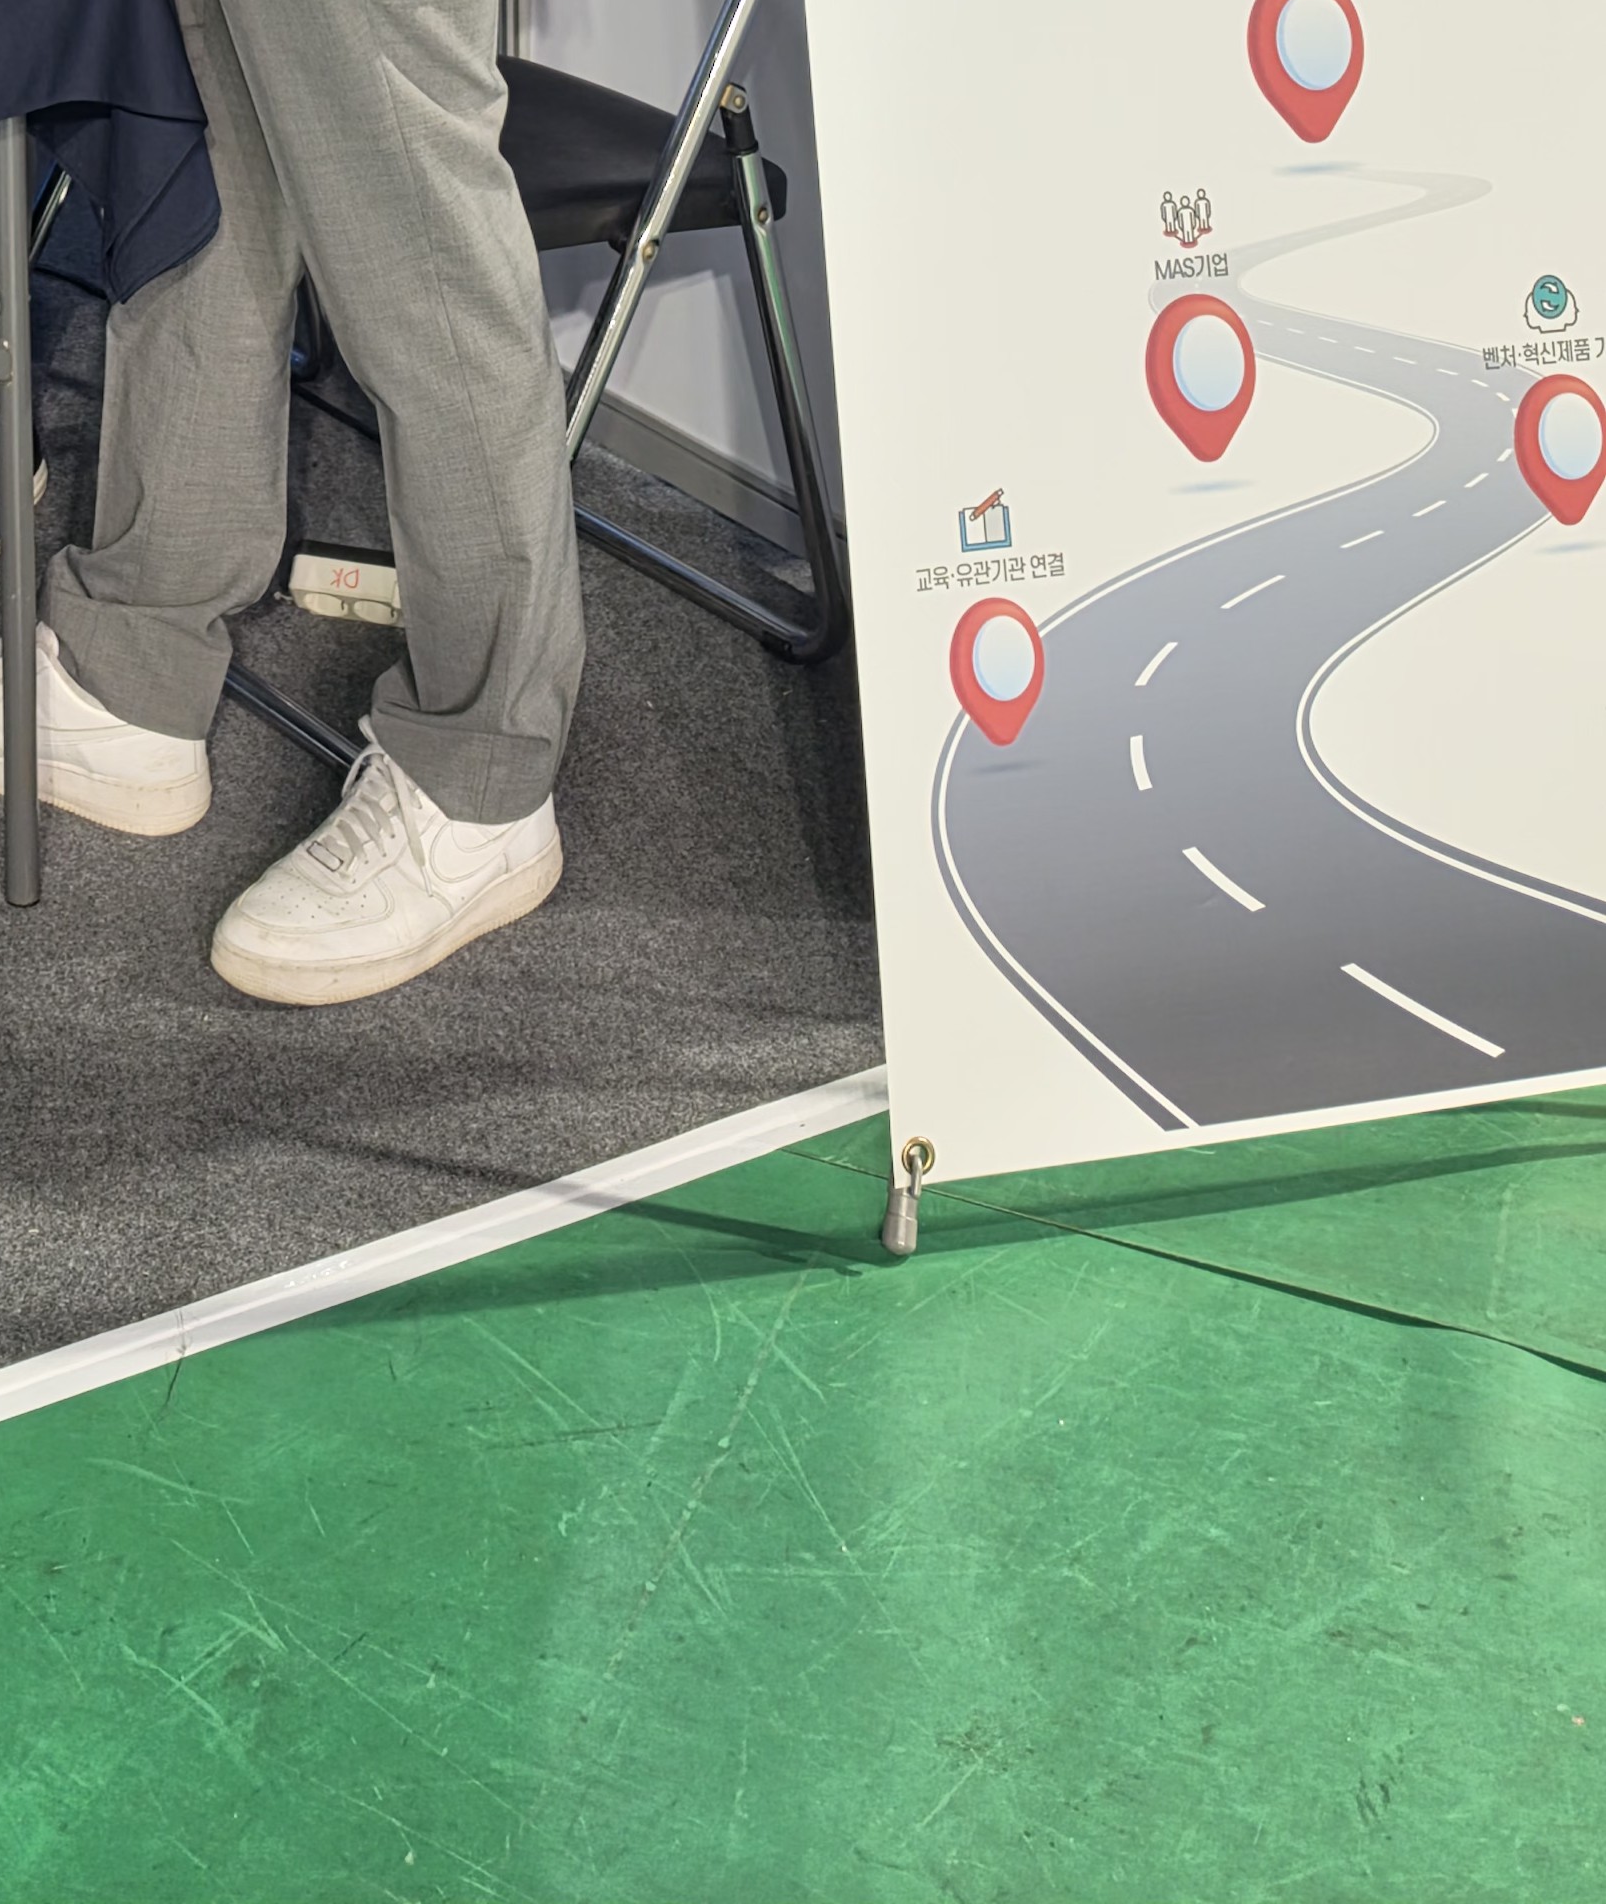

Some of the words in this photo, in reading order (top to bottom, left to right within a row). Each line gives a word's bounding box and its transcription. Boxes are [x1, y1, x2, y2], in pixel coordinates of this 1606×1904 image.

[1154, 252, 1229, 281] MAS기업
[1482, 337, 1591, 370] 벤처·혁신제품
[915, 556, 1027, 592] 교육·유관기관
[1030, 552, 1065, 579] 연결
